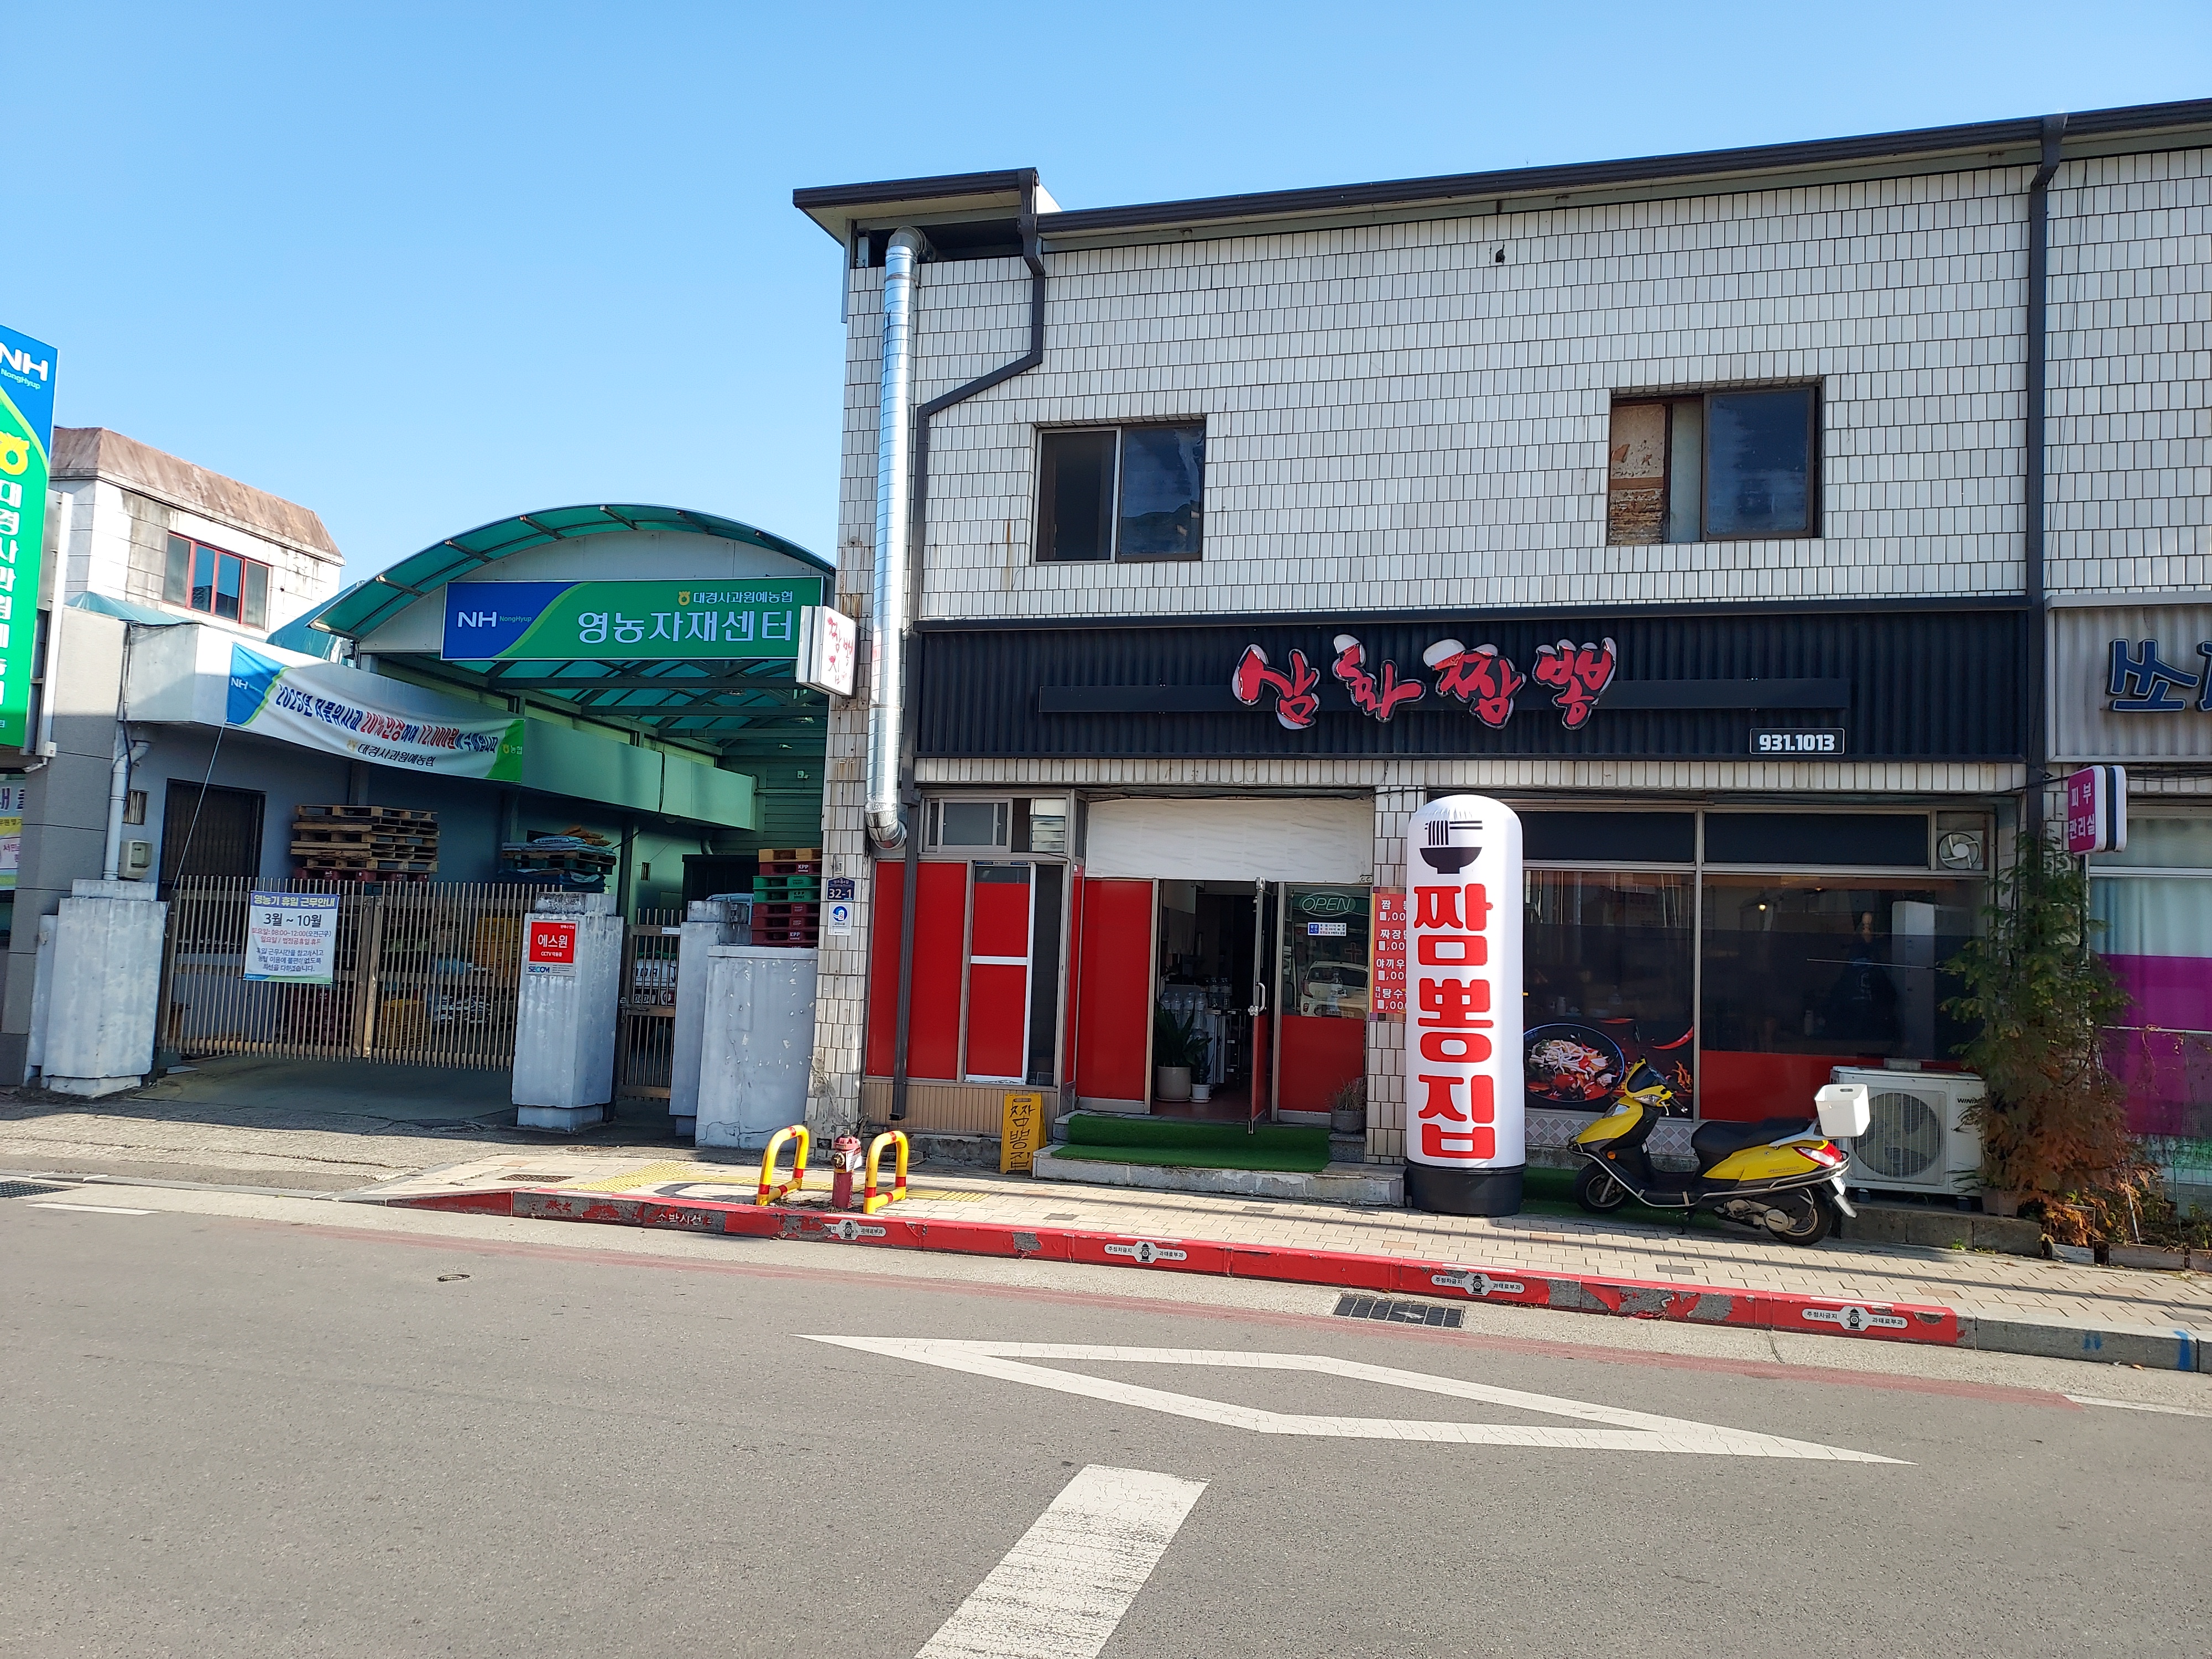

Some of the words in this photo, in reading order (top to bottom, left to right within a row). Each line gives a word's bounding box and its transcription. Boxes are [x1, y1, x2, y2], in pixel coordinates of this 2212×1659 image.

[0, 342, 48, 381] NH
[1, 368, 40, 390] NongHyup
[693, 591, 792, 604] 대경사과원예농협
[458, 612, 497, 627] NH
[578, 611, 792, 643] 영농자재센터
[231, 677, 248, 690] NH
[276, 684, 313, 717] 2025년
[1759, 734, 1835, 750] 931.1013
[358, 744, 436, 767] 대경사과원예농협
[510, 745, 523, 755] 농협
[2072, 782, 2091, 807] 피부
[2069, 813, 2095, 839] 관리실
[254, 894, 279, 906] 영농기
[281, 896, 299, 907] 휴일
[300, 898, 335, 907] 근무안내
[828, 889, 852, 898] 32-1
[1302, 898, 1351, 911] OPEN
[263, 913, 283, 927] 3월
[297, 914, 322, 928] 10월
[538, 934, 567, 948] 에스원
[1383, 988, 1406, 999] 탕수
[1413, 883, 1496, 1160] 짬뽕집
[1009, 1104, 1036, 1169] 짬뽕집
[1435, 1277, 1463, 1285] 주정차금지
[1807, 1311, 1838, 1319] 주정차금지
[1872, 1317, 1903, 1326] 과태료부과
